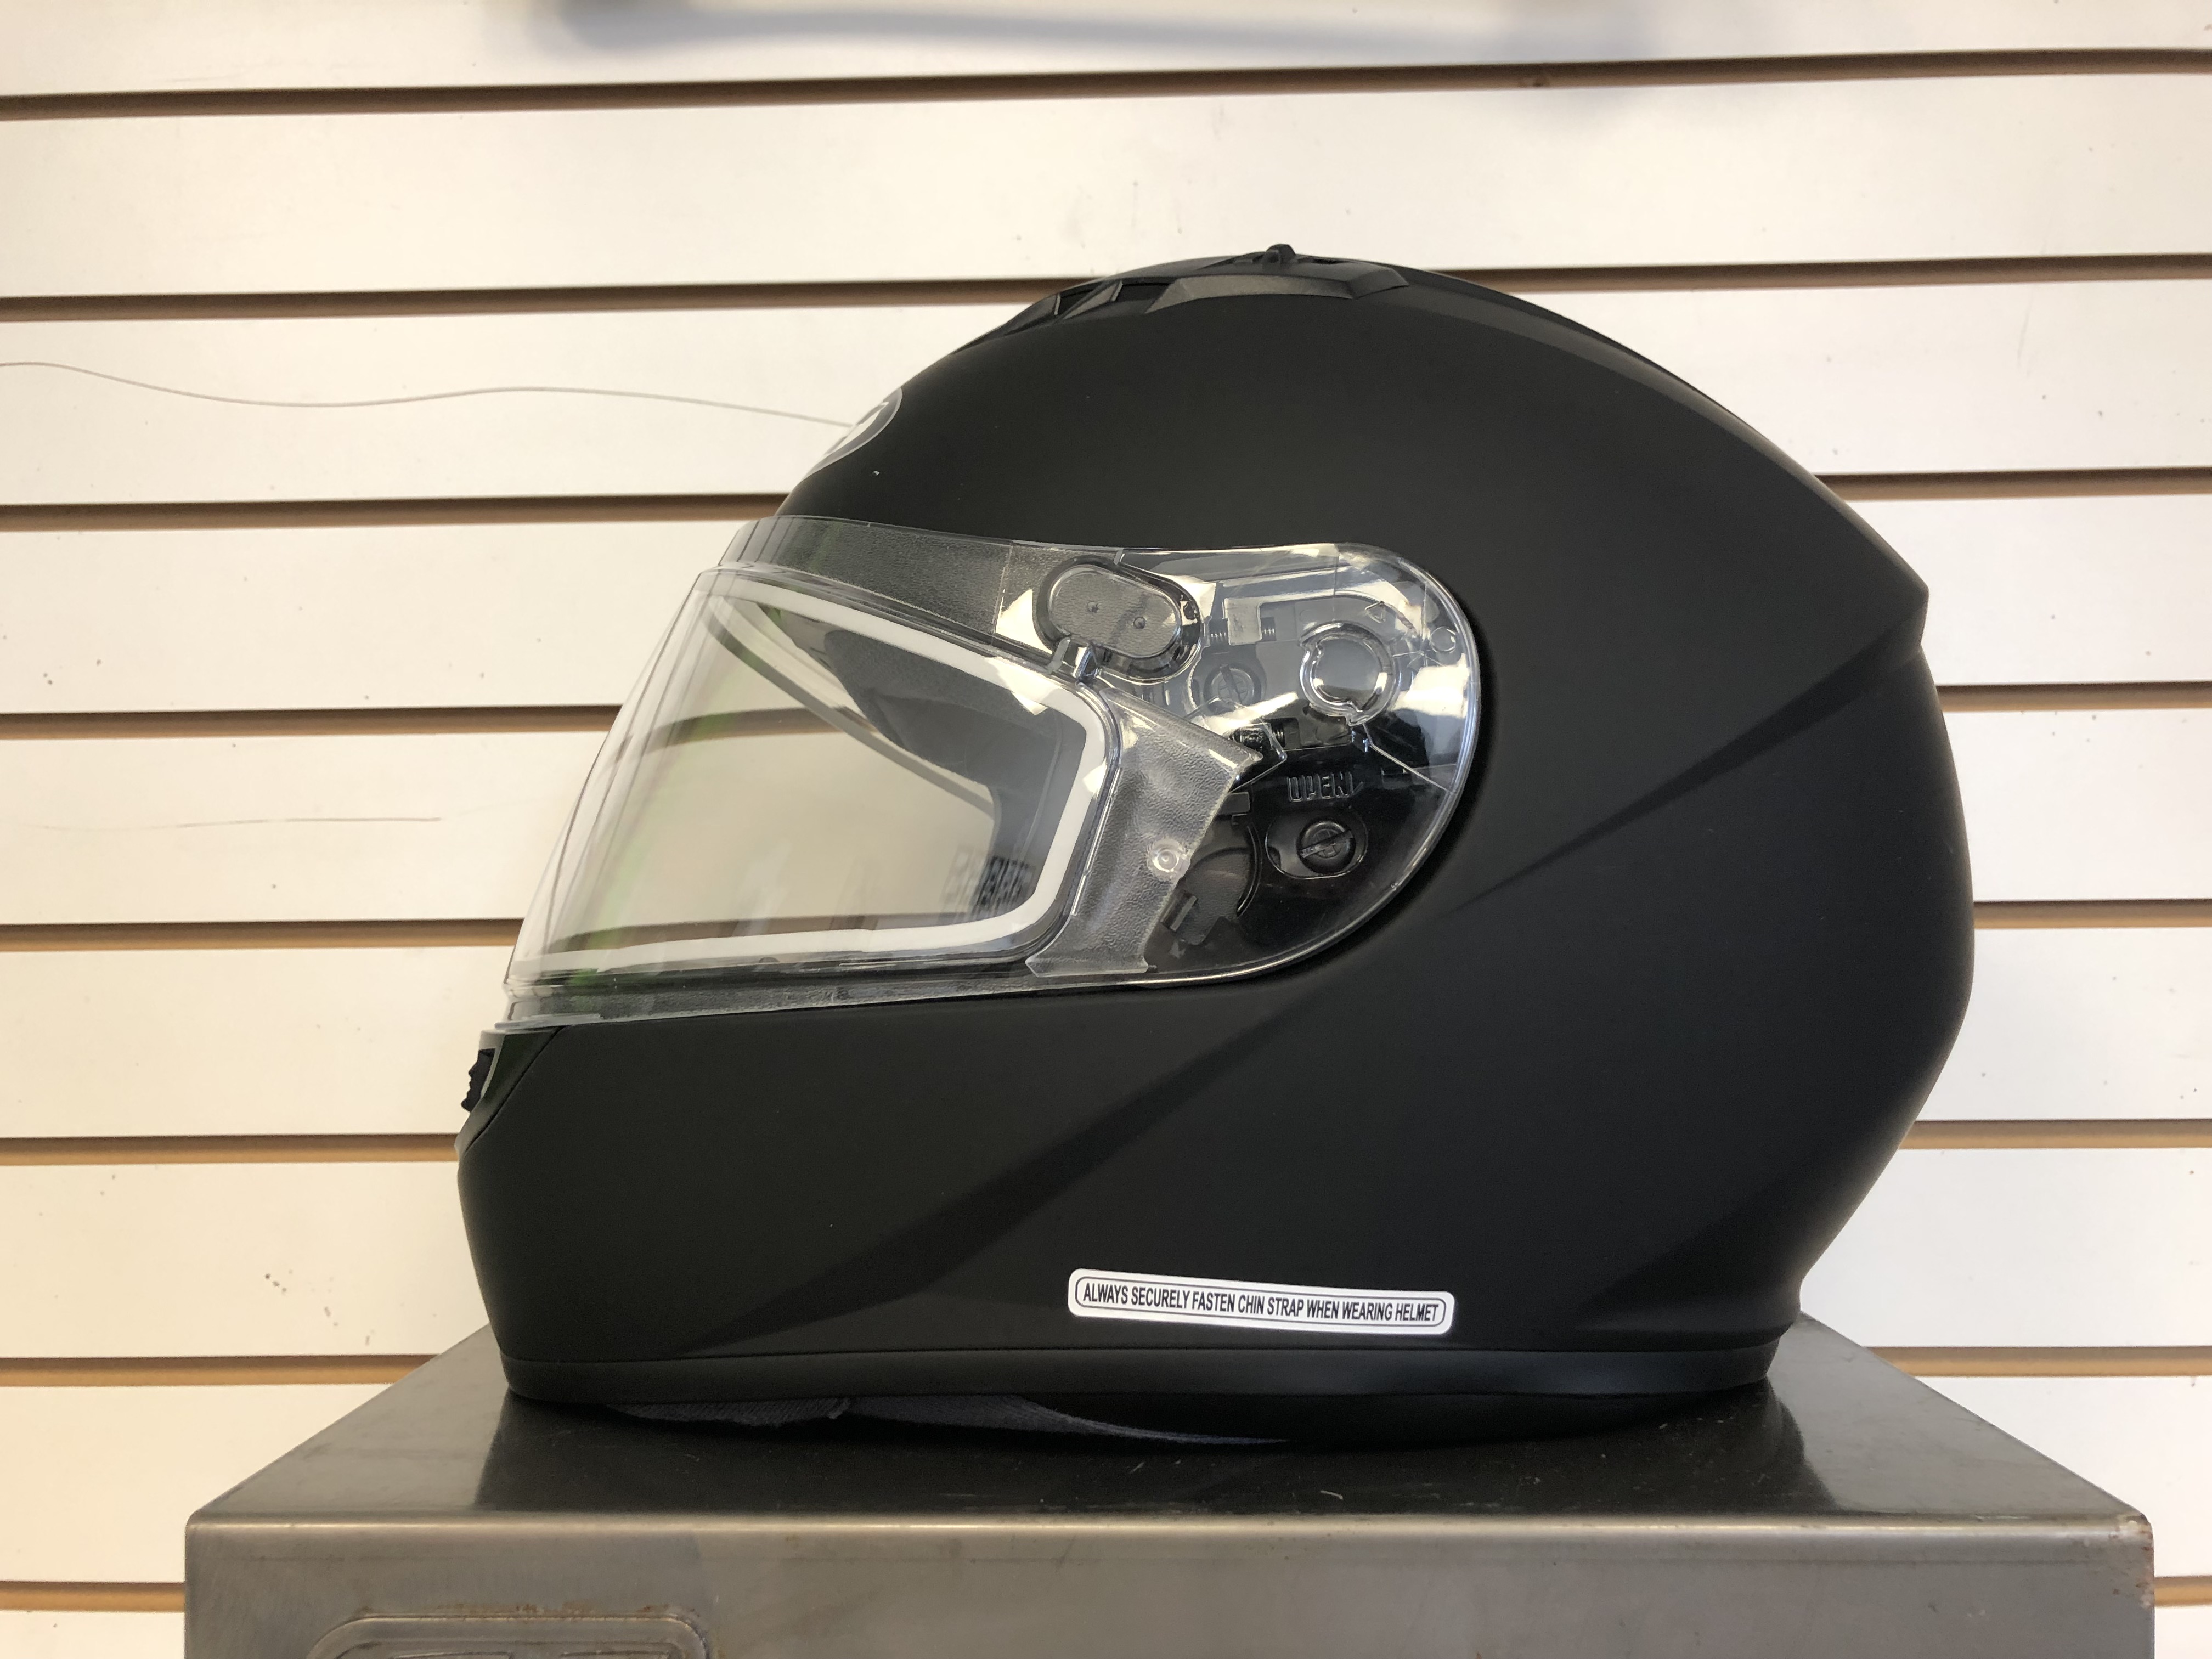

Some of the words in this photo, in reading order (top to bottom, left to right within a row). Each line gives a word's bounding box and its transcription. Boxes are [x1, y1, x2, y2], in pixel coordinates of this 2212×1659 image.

[1082, 1282, 1128, 1304] ALWAYS
[1131, 1286, 1190, 1309] SECURELY
[1192, 1291, 1236, 1312] FASTEN
[1238, 1295, 1265, 1315] CHIN
[1267, 1296, 1305, 1317] STRAP
[1306, 1299, 1340, 1319] WHEN
[1341, 1301, 1393, 1321] WEARING
[1394, 1303, 1440, 1322] HELMET
